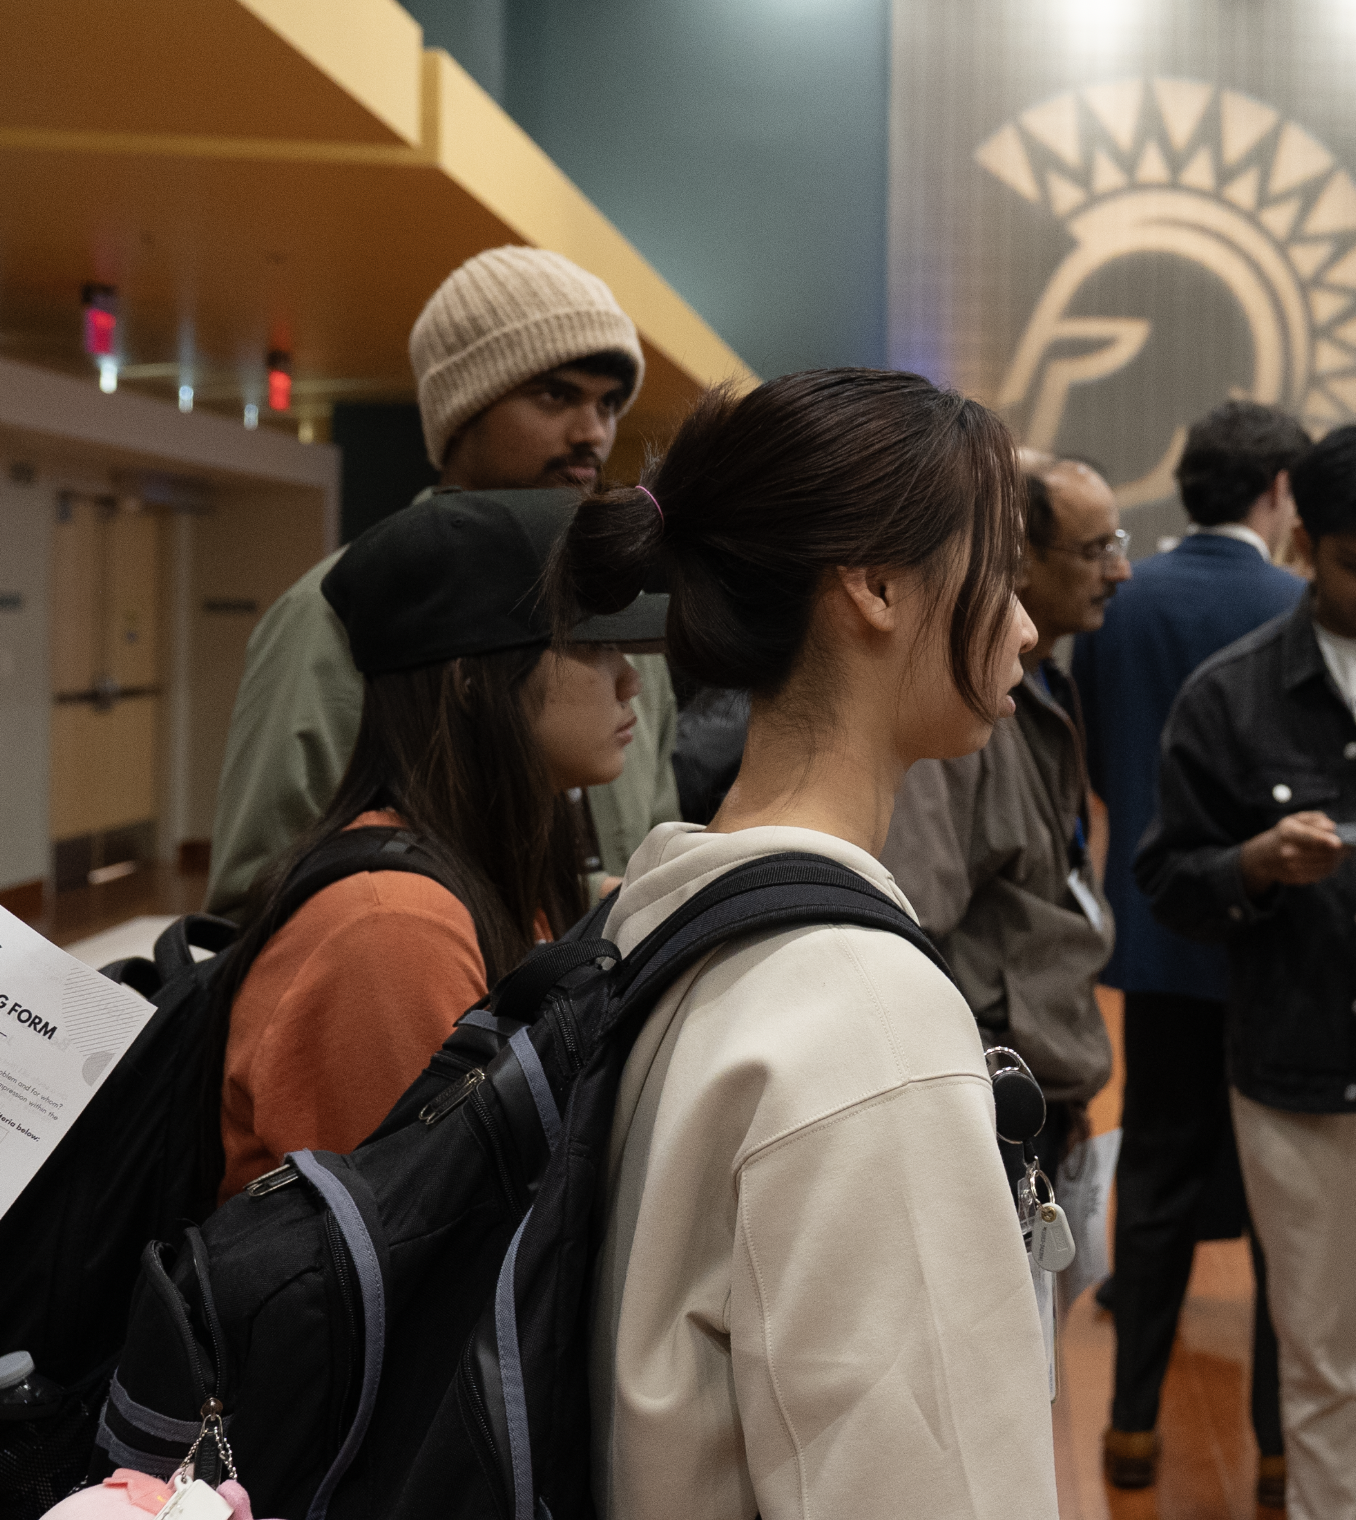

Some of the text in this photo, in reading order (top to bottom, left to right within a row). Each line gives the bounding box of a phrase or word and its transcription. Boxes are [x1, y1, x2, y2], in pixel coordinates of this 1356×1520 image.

[7, 1002, 58, 1040] FORM
[17, 1081, 32, 1092] and
[30, 1087, 41, 1097] for
[40, 1094, 64, 1110] whom?
[28, 1100, 47, 1114] within
[48, 1111, 59, 1121] the
